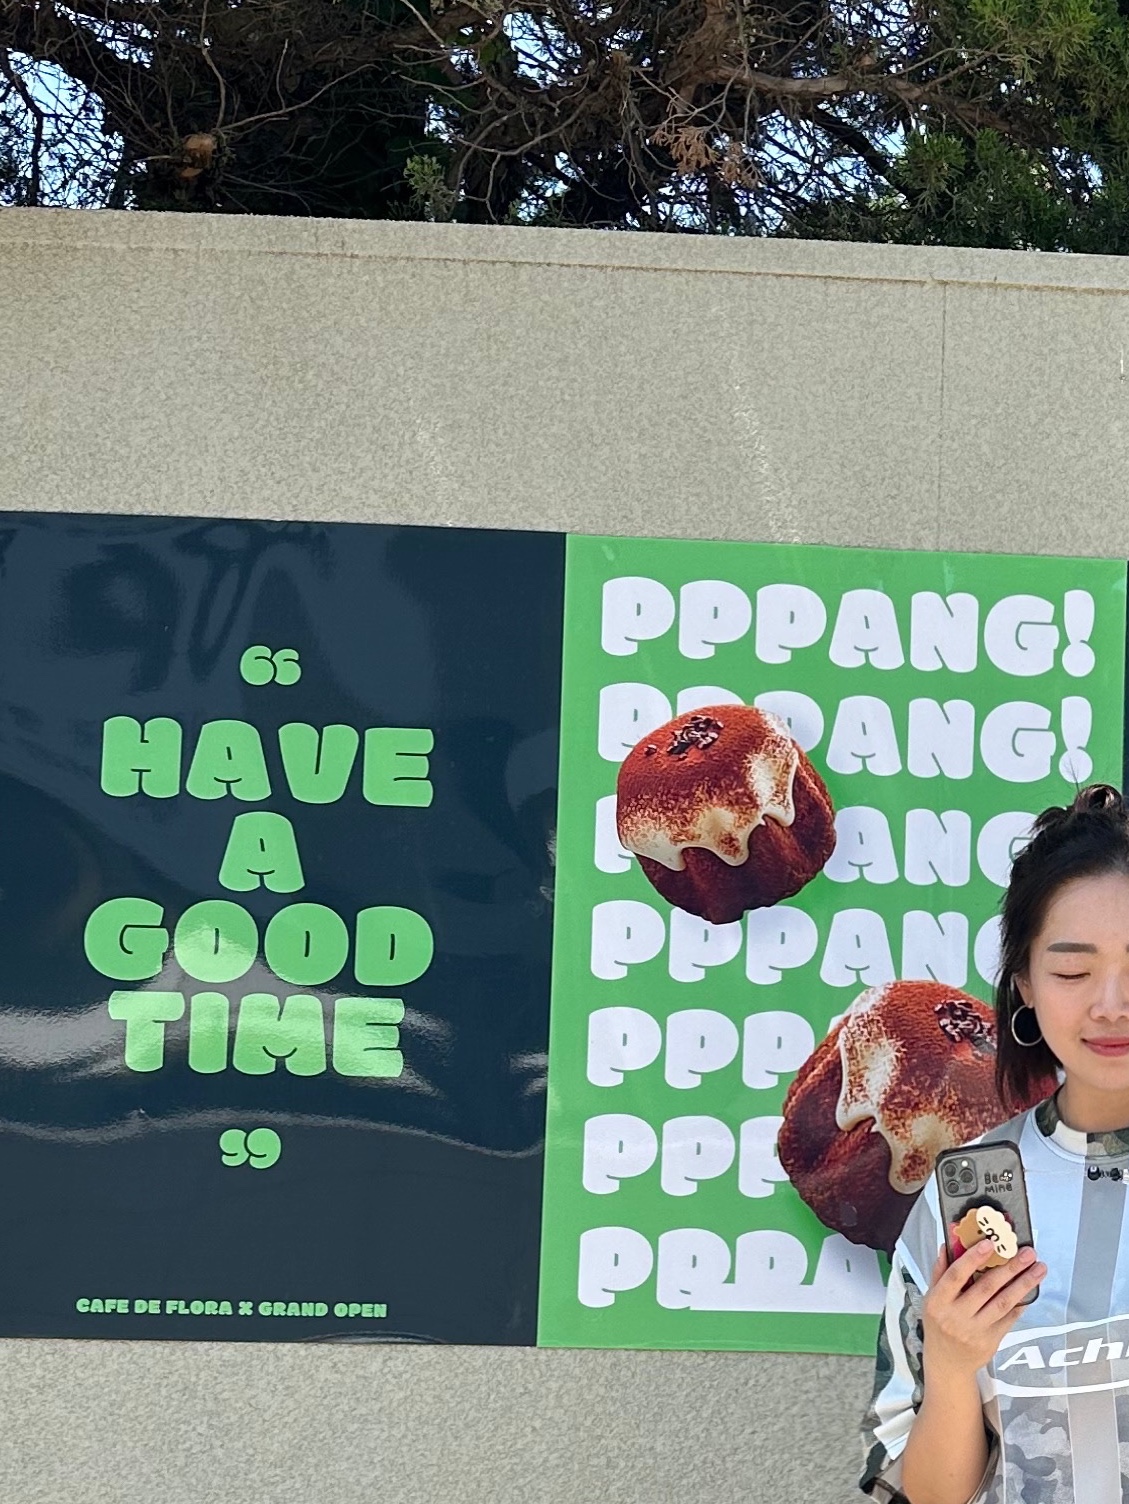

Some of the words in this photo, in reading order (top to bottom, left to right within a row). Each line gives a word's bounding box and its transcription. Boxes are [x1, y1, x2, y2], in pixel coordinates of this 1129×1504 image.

[600, 576, 1096, 678] PPPANG!
[100, 715, 435, 808] HAVE
[597, 682, 1093, 784] PPANG!
[219, 811, 305, 894] A
[83, 897, 434, 987] GOOD
[108, 990, 405, 1078] TIME
[76, 1298, 129, 1313] CAFE
[134, 1299, 161, 1314] DE
[166, 1300, 233, 1315] FLORA
[258, 1302, 328, 1317] GRAND
[333, 1303, 388, 1318] OPEN
